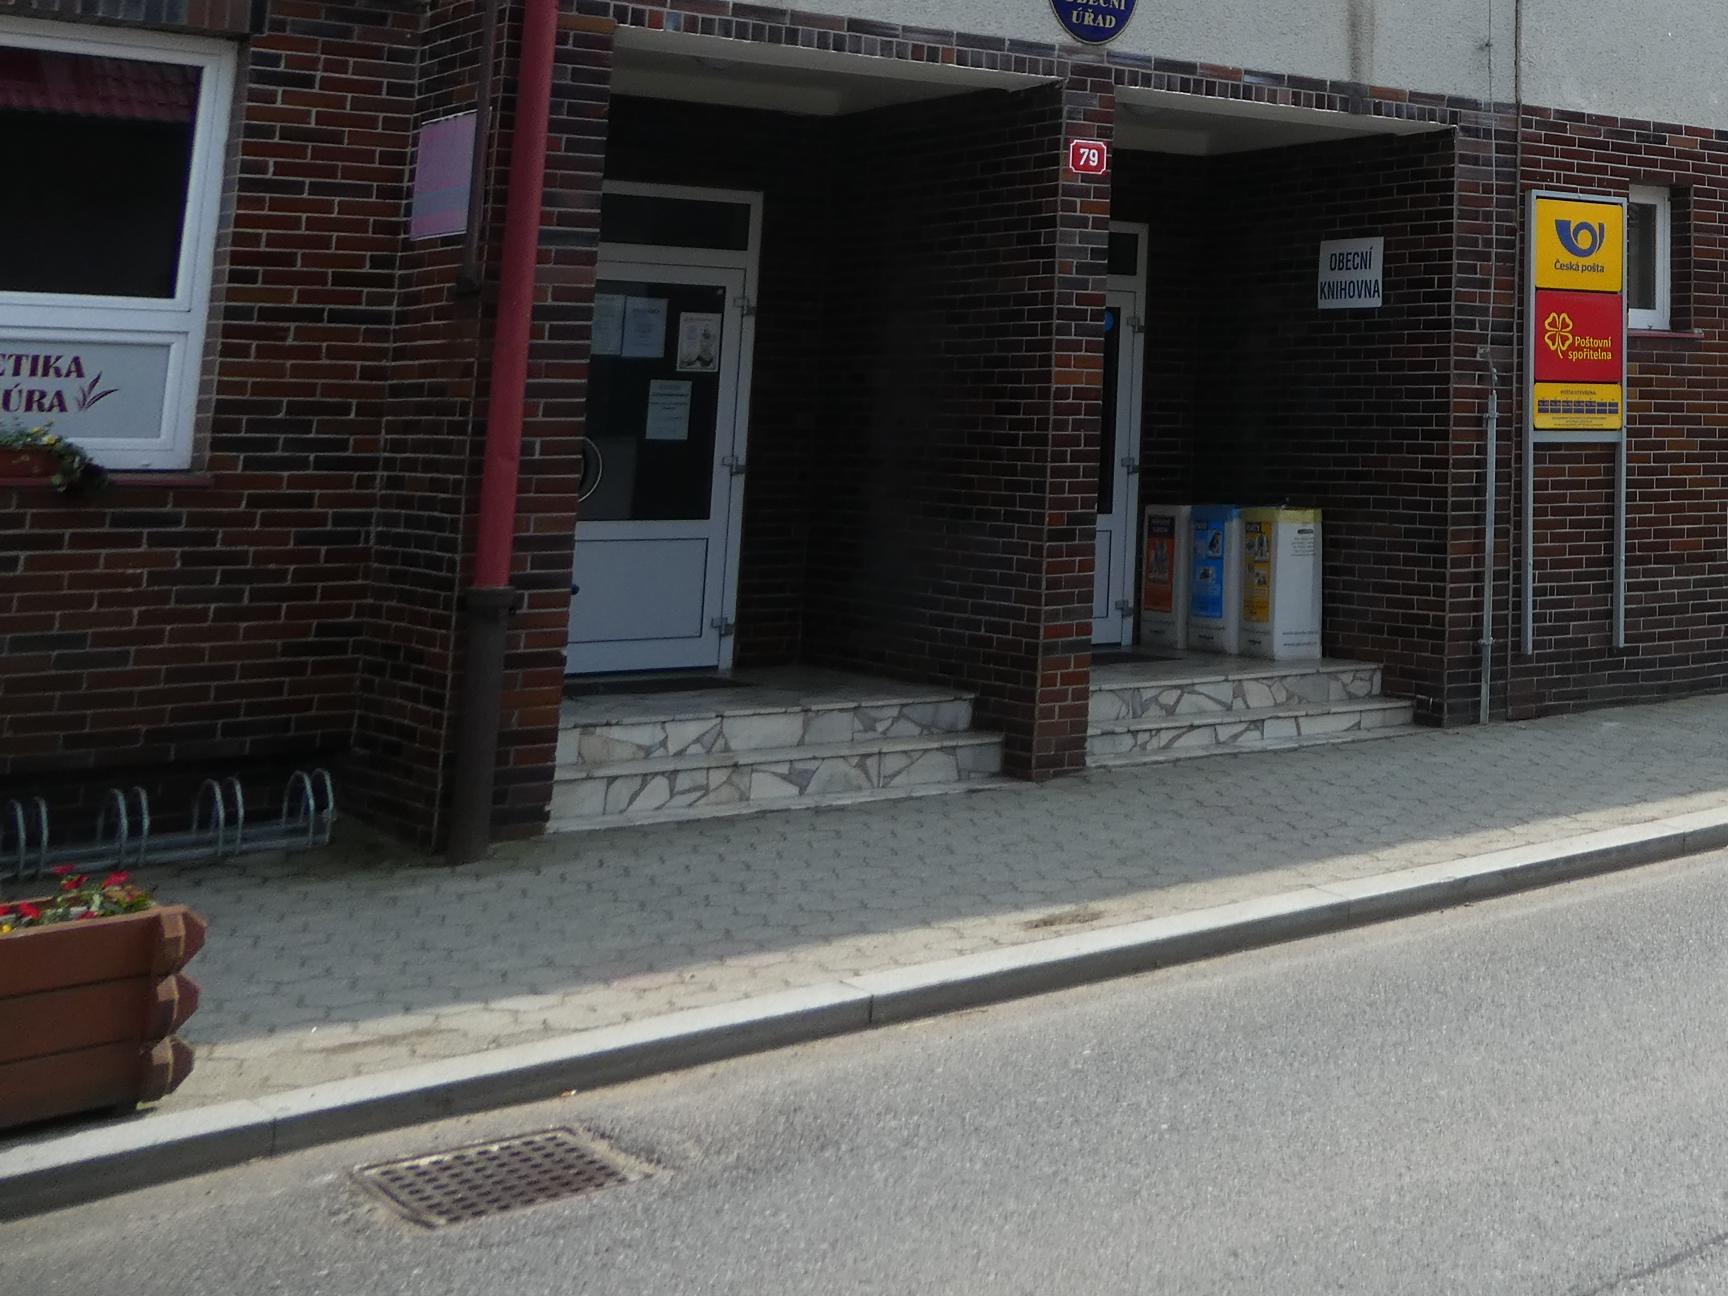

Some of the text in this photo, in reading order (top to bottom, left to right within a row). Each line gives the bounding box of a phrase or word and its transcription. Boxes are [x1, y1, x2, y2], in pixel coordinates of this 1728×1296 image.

[1072, 7, 1116, 28] ÚŘAD
[1080, 148, 1098, 166] 79
[1329, 245, 1373, 272] OBECNÍ
[1554, 259, 1605, 274] Česká pošta
[1319, 278, 1381, 300] KNIHOVNA
[1575, 336, 1612, 347] Poštovní
[1568, 349, 1612, 362] spořitelna
